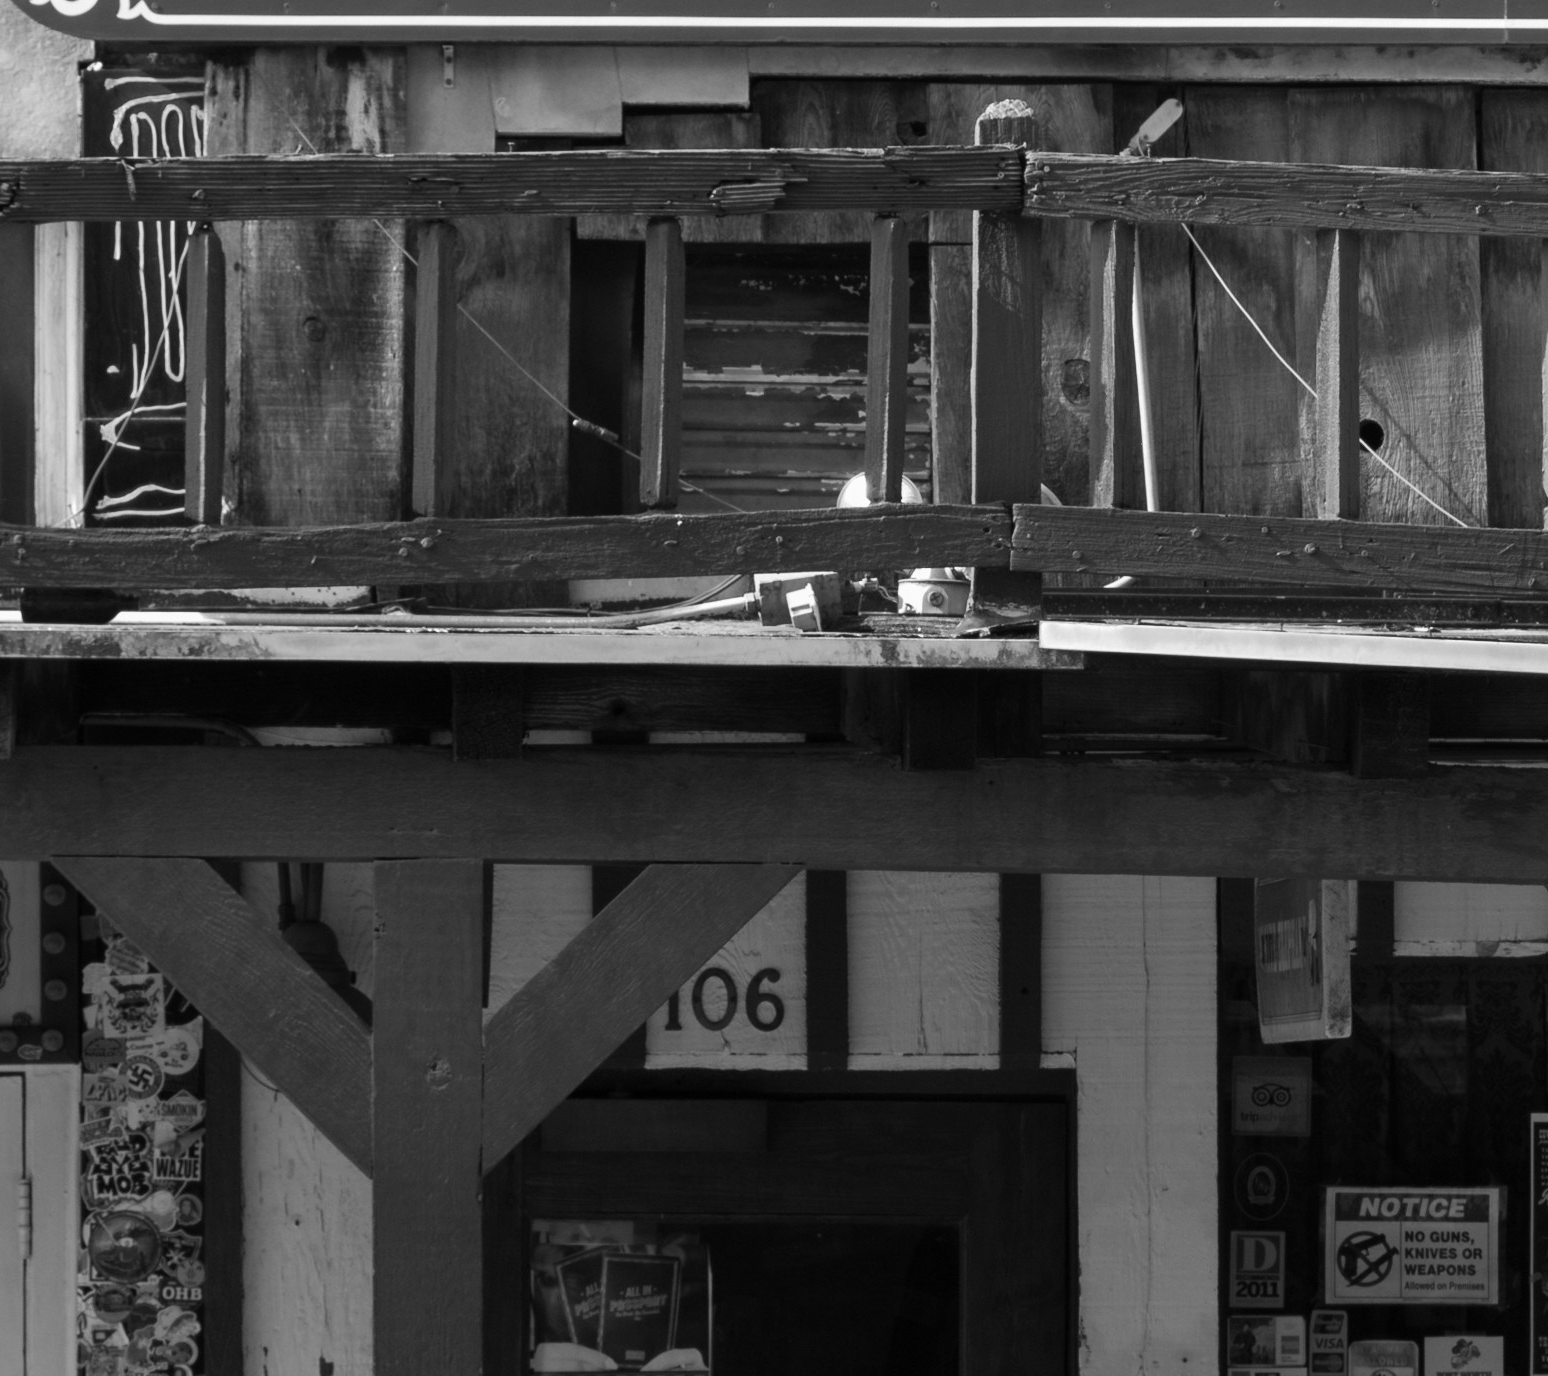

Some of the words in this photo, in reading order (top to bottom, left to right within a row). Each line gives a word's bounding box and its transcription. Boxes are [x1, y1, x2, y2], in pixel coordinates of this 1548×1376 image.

[664, 968, 785, 1032] 106
[1359, 1197, 1467, 1218] NOTICE
[1404, 1231, 1425, 1245] NO
[1429, 1231, 1475, 1245] GUNS,
[1404, 1247, 1457, 1260] KNIVES
[1462, 1247, 1483, 1260] OR
[1404, 1264, 1476, 1276] WEAPONS
[1235, 1281, 1280, 1298] 2011
[1404, 1282, 1436, 1291] Allowed
[1437, 1282, 1447, 1291] on
[1449, 1282, 1485, 1291] Premises
